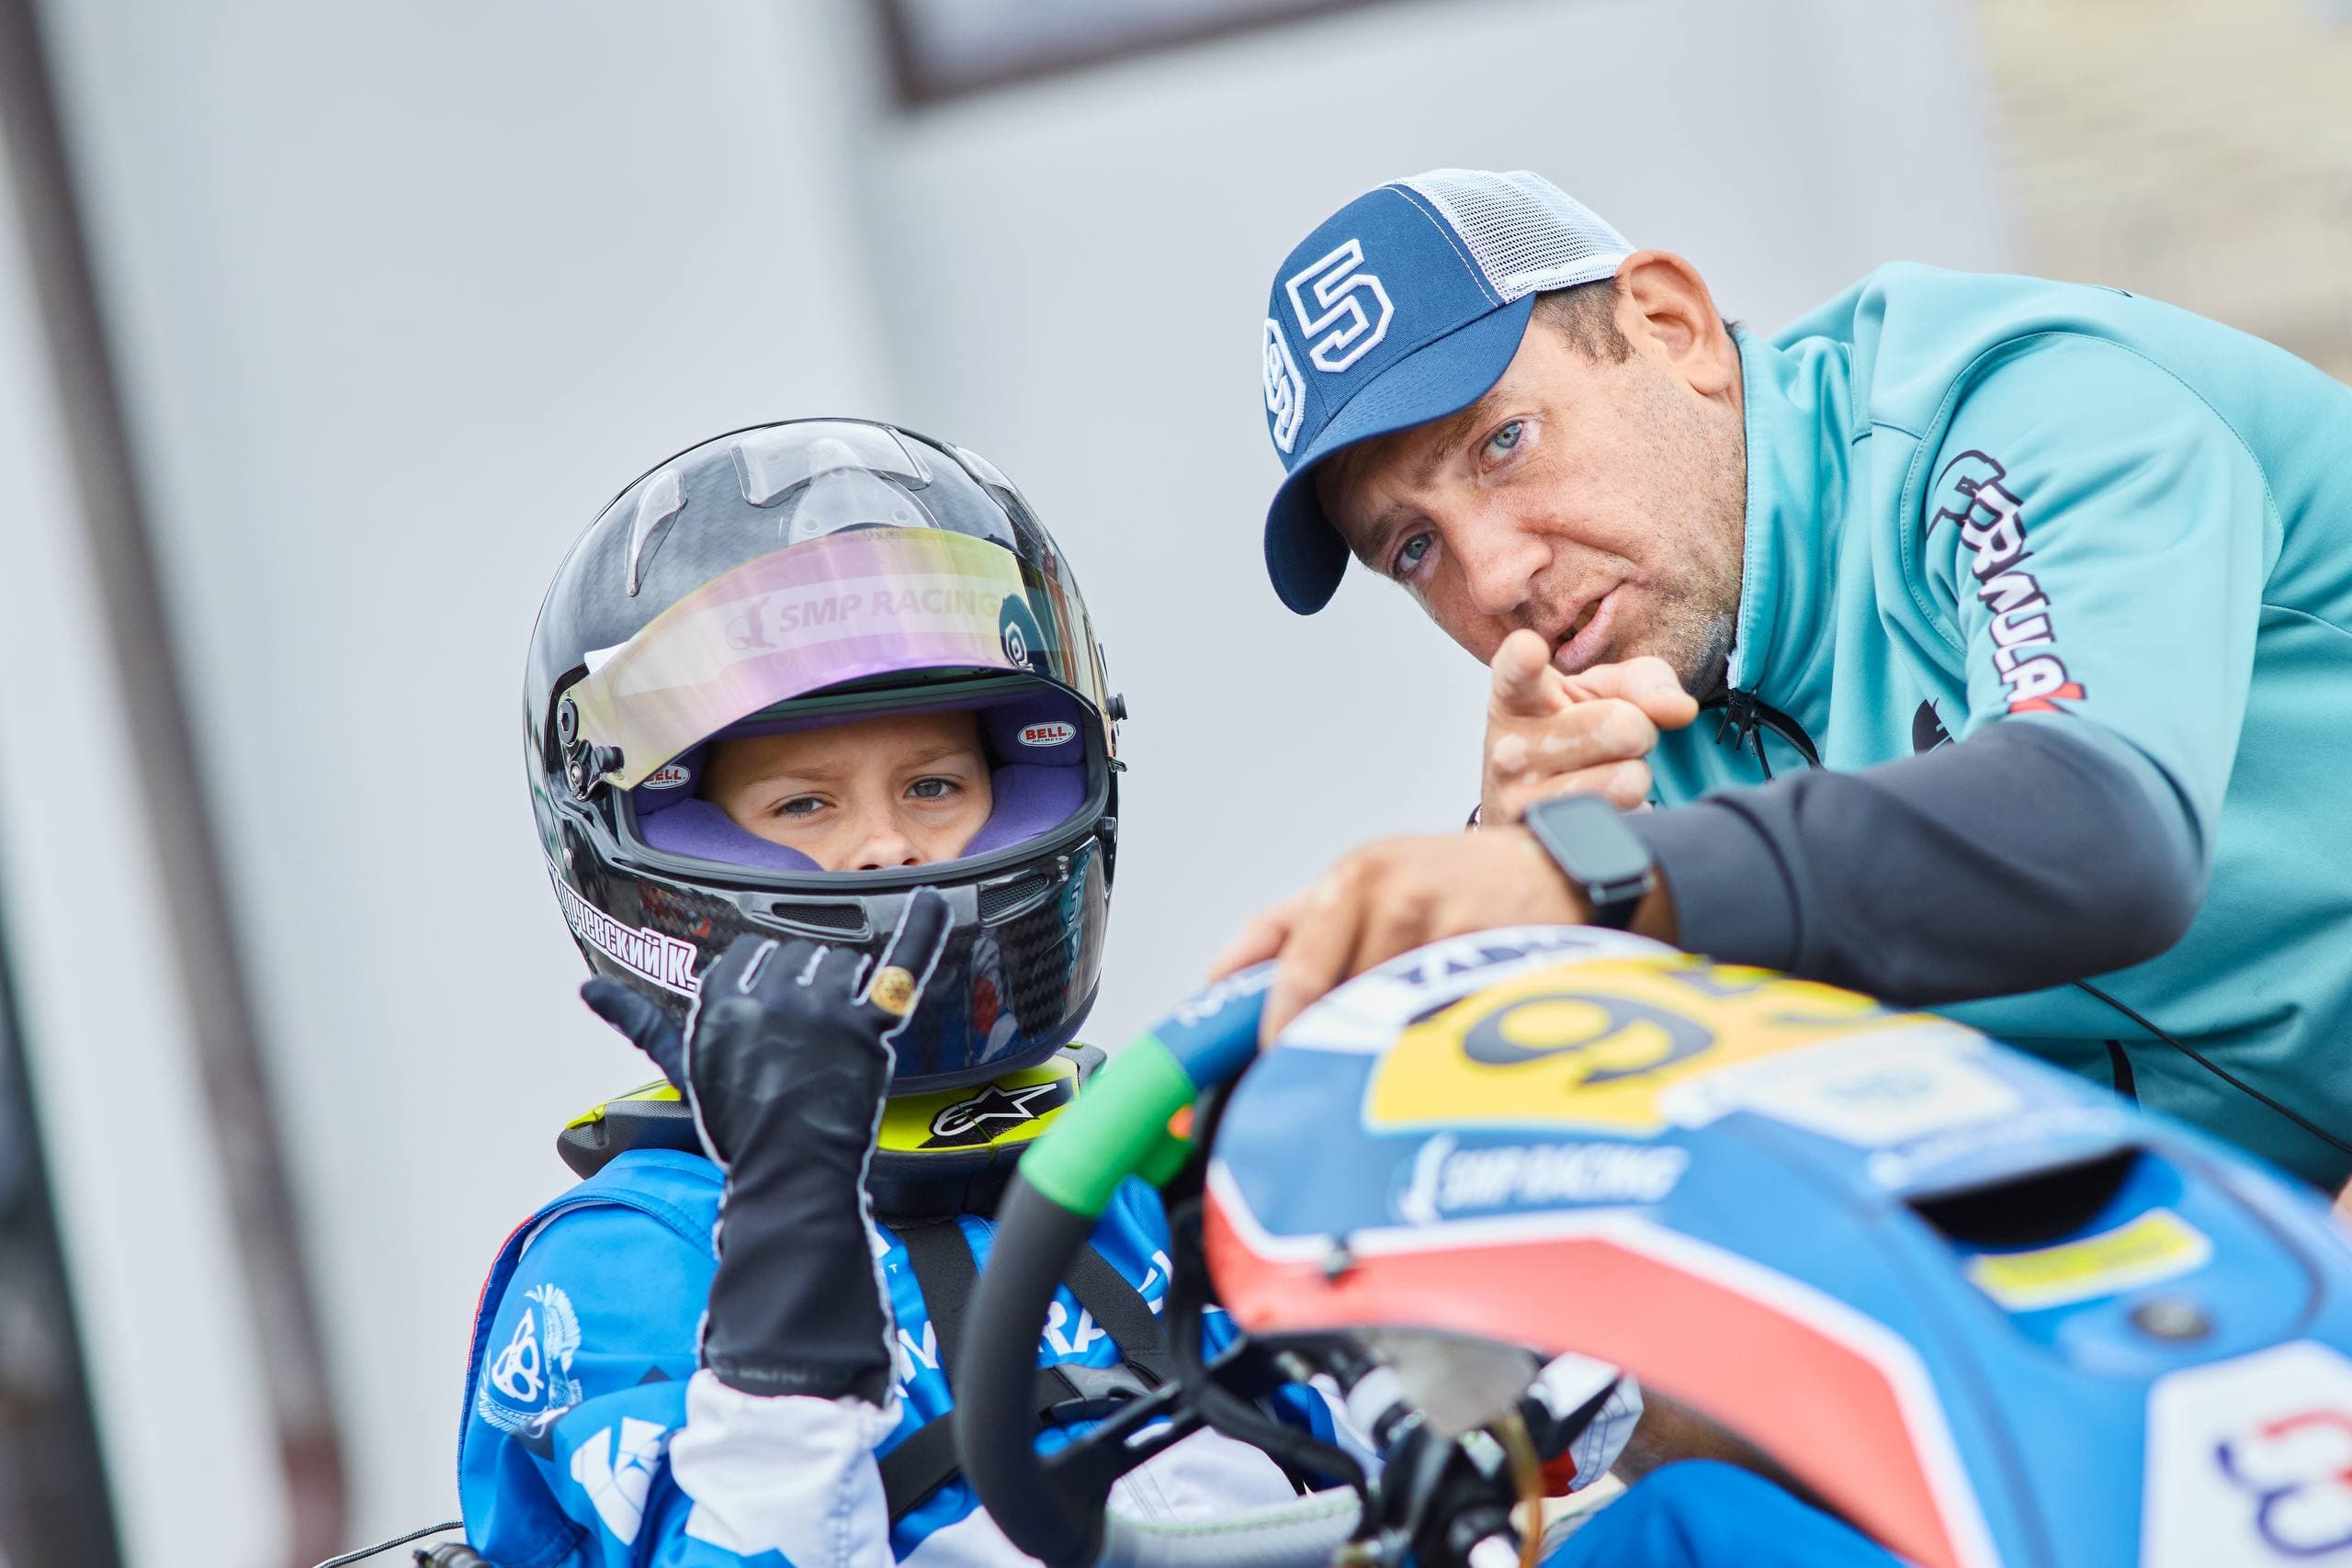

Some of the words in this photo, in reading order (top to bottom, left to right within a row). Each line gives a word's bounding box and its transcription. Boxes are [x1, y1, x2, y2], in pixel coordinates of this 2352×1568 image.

[1262, 238, 1395, 454] 95
[779, 593, 862, 633] SMP
[873, 588, 1000, 620] RACING
[1025, 726, 1068, 740] BELL
[646, 769, 683, 782] ELL
